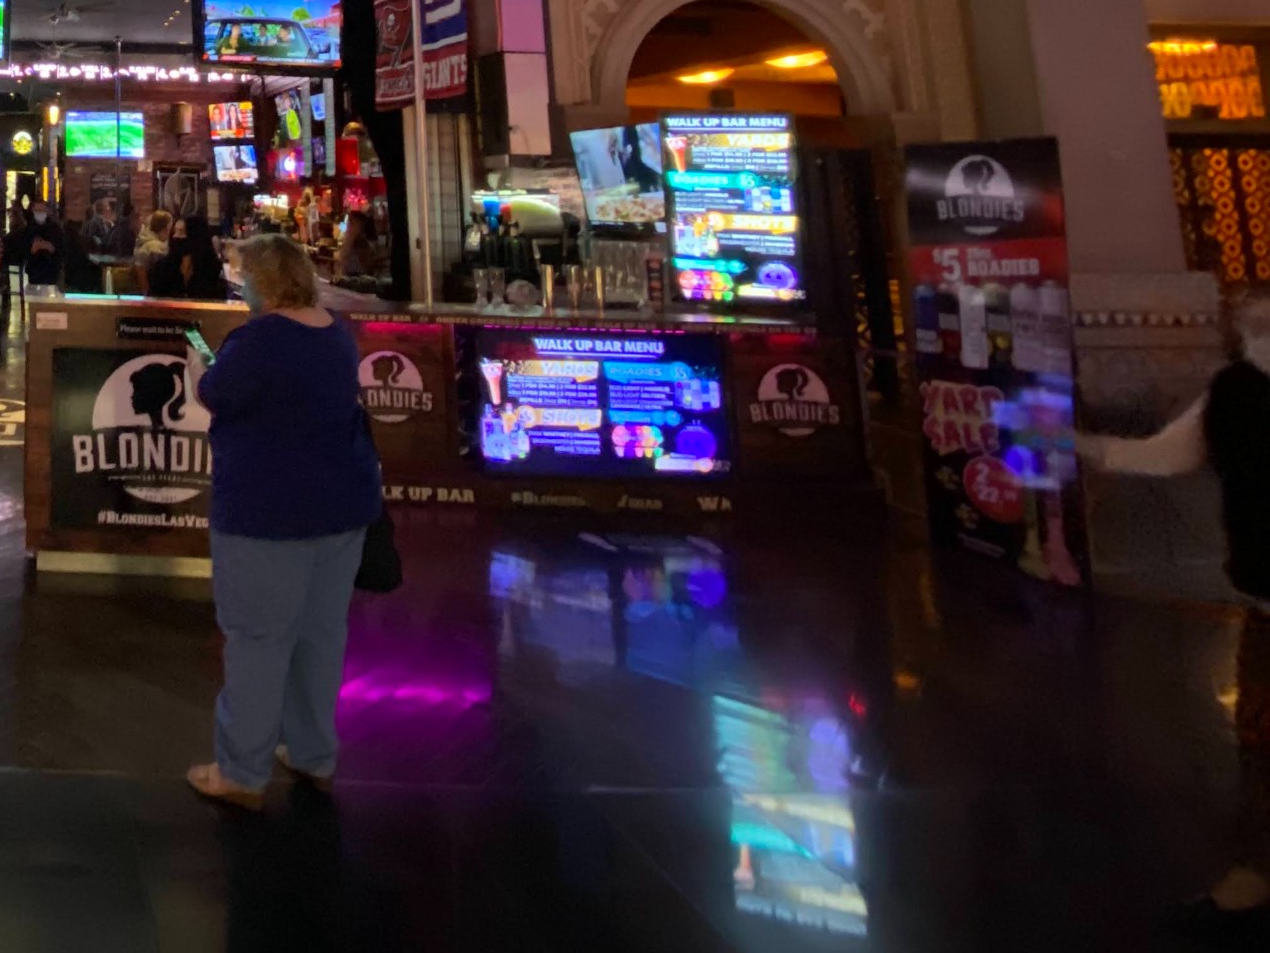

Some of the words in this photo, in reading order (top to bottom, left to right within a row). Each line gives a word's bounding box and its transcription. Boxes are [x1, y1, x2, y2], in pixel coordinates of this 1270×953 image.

[423, 53, 467, 90] GIANTS
[667, 117, 701, 127] WALK
[703, 117, 720, 127] UP
[722, 117, 747, 127] BAR
[749, 117, 787, 127] MENU
[935, 197, 1025, 223] BLONDIES
[967, 258, 1040, 277] ROADIES
[535, 338, 572, 352] WALK
[575, 339, 593, 351] UP
[595, 340, 621, 352] BAR
[624, 341, 664, 353] MENU
[358, 389, 433, 411] ONDIES
[749, 401, 840, 425] BLONDIES
[922, 415, 1000, 455] SALE
[72, 432, 212, 474] BLONDI
[408, 486, 433, 501] UP
[437, 488, 475, 503] BAR
